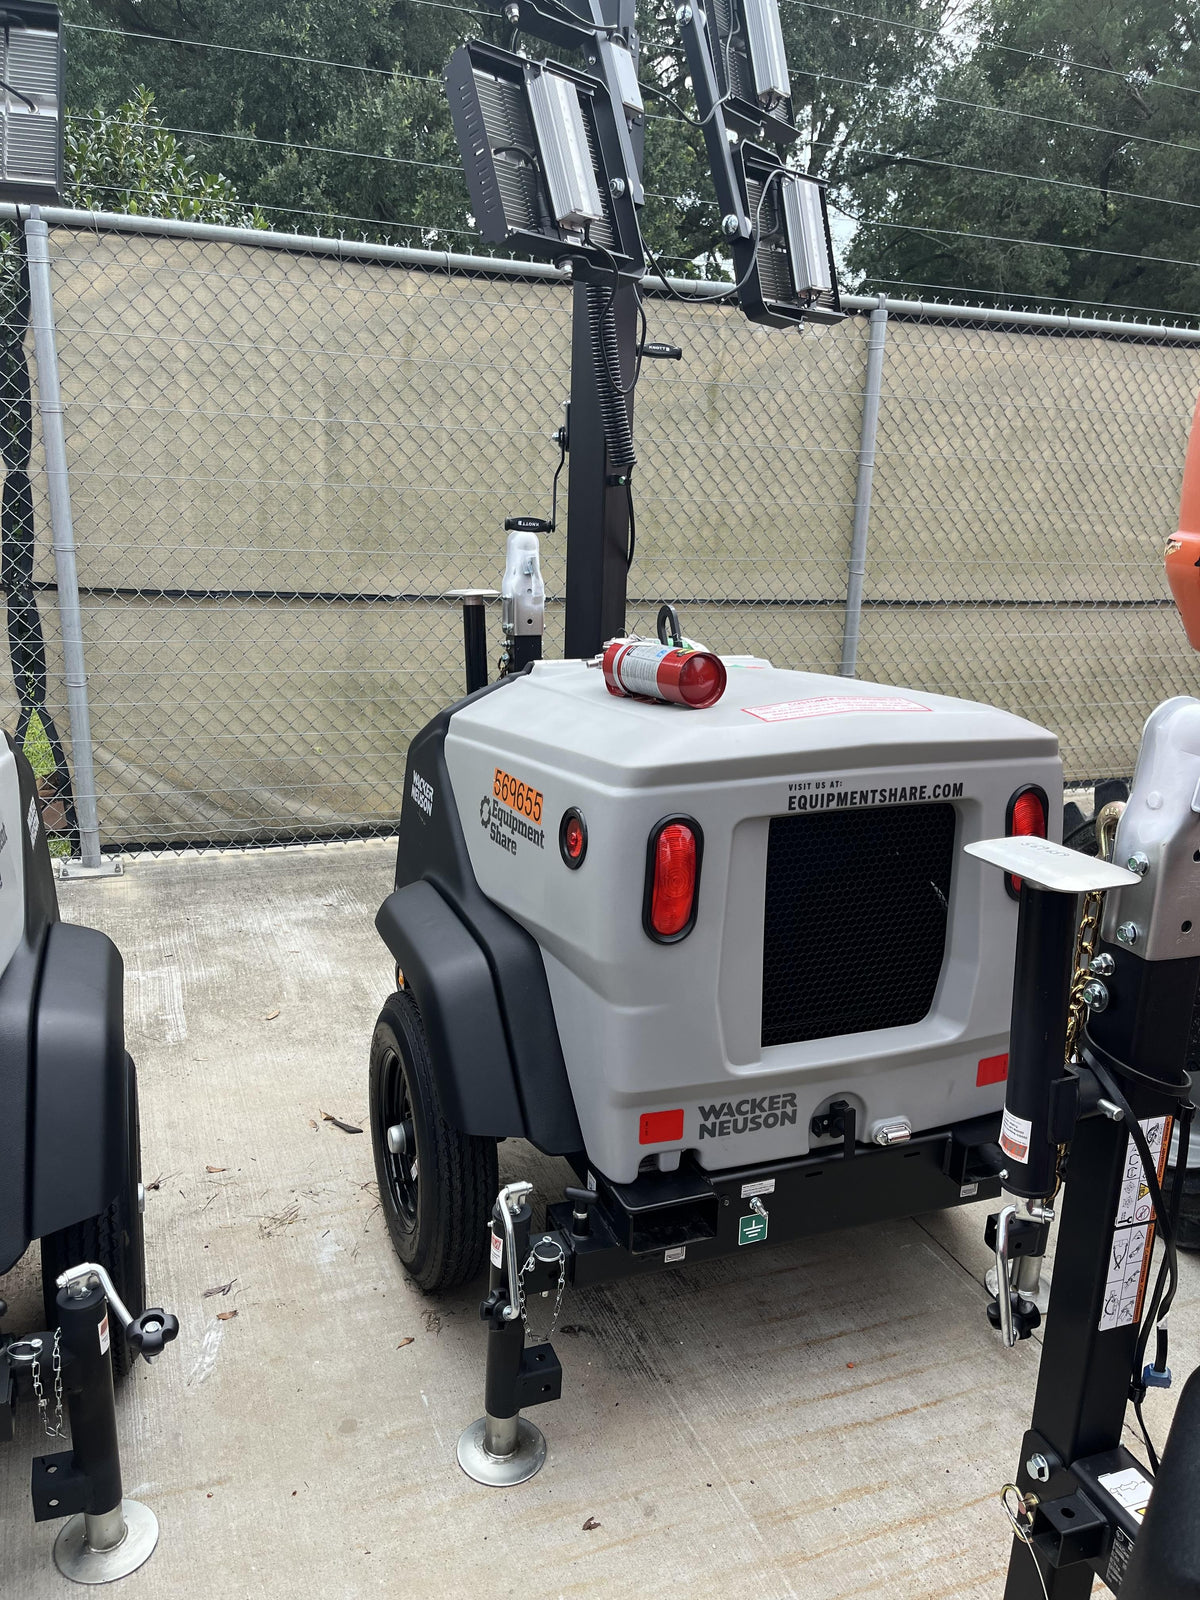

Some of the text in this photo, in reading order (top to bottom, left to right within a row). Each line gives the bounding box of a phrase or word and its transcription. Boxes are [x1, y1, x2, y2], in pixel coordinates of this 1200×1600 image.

[410, 783, 433, 817] NEUSON
[412, 770, 434, 802] WACKER
[493, 769, 543, 822] 569655
[788, 780, 842, 792] VISIT US AT:
[788, 782, 964, 811] EQUIPMENTSHARE.COM
[489, 823, 517, 856] Share
[491, 798, 545, 849] Equipment
[698, 1092, 797, 1121] WACKER
[698, 1109, 797, 1139] NEUSON
